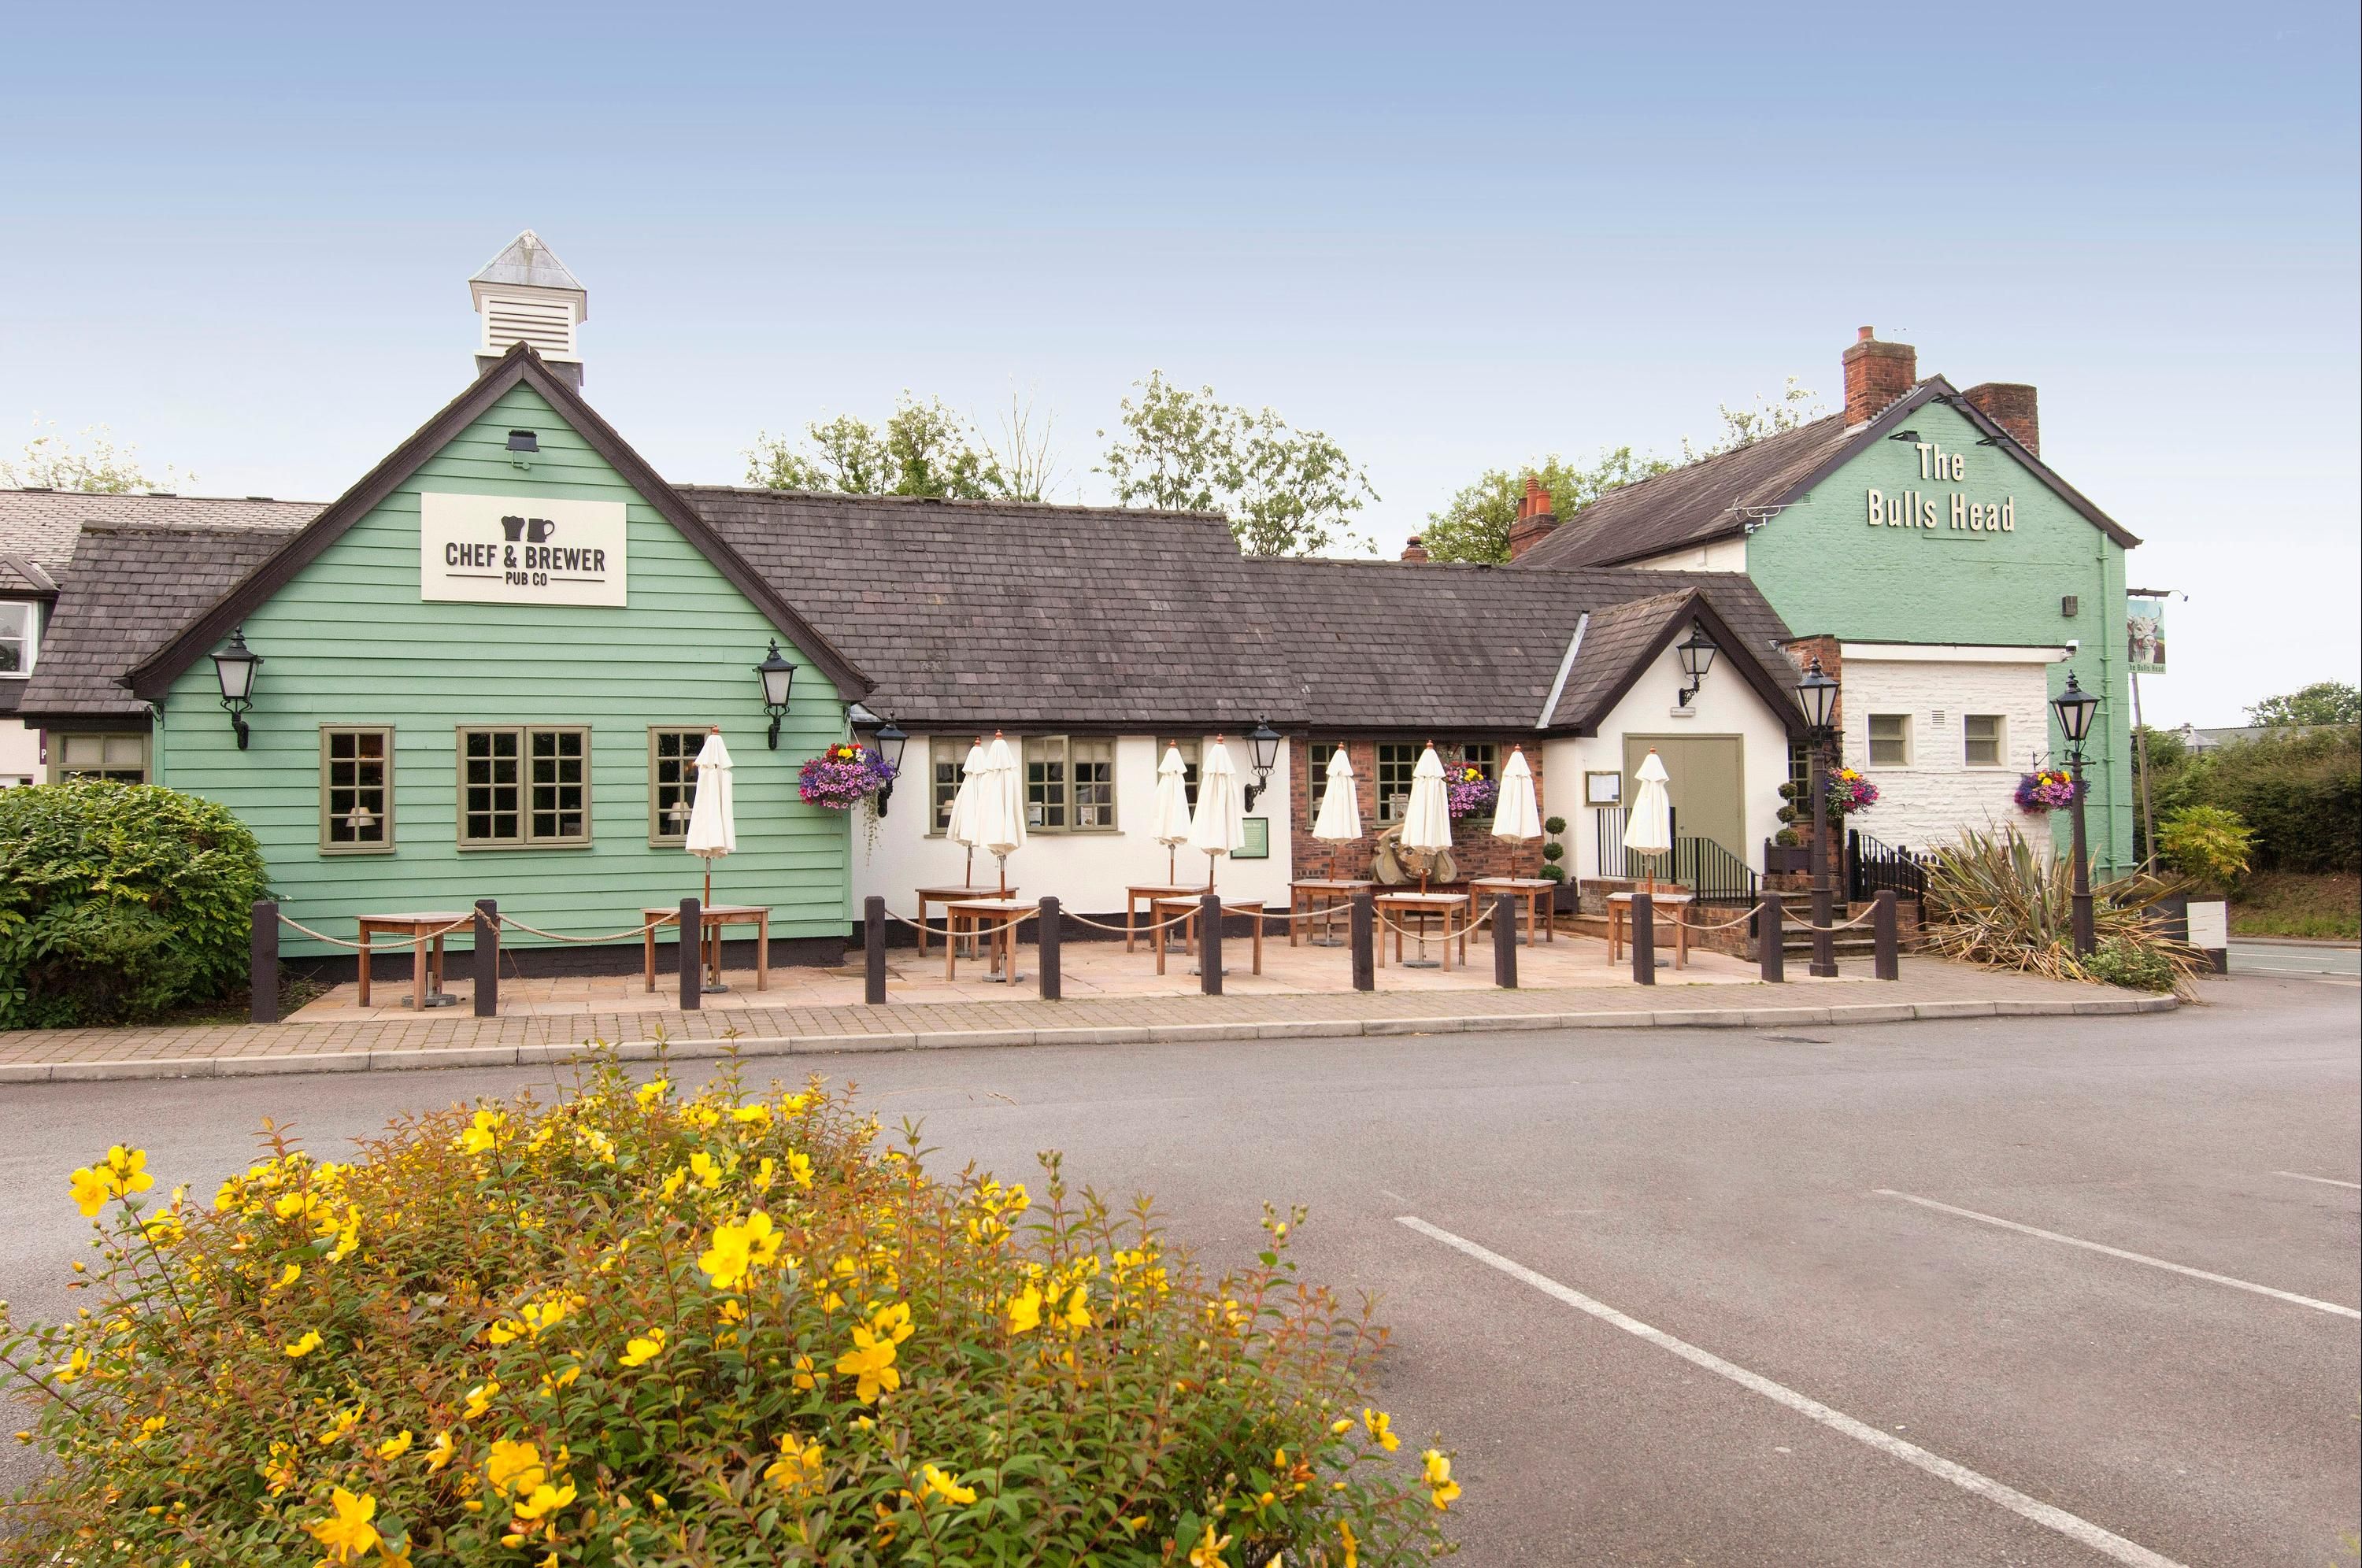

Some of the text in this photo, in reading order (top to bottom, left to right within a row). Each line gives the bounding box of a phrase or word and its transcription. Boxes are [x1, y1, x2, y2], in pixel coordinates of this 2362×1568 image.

[1916, 442, 1965, 481] The
[1868, 489, 2015, 531] Bulls Head
[446, 542, 605, 571] CHEF & BREWER
[505, 571, 547, 586] PUB CO
